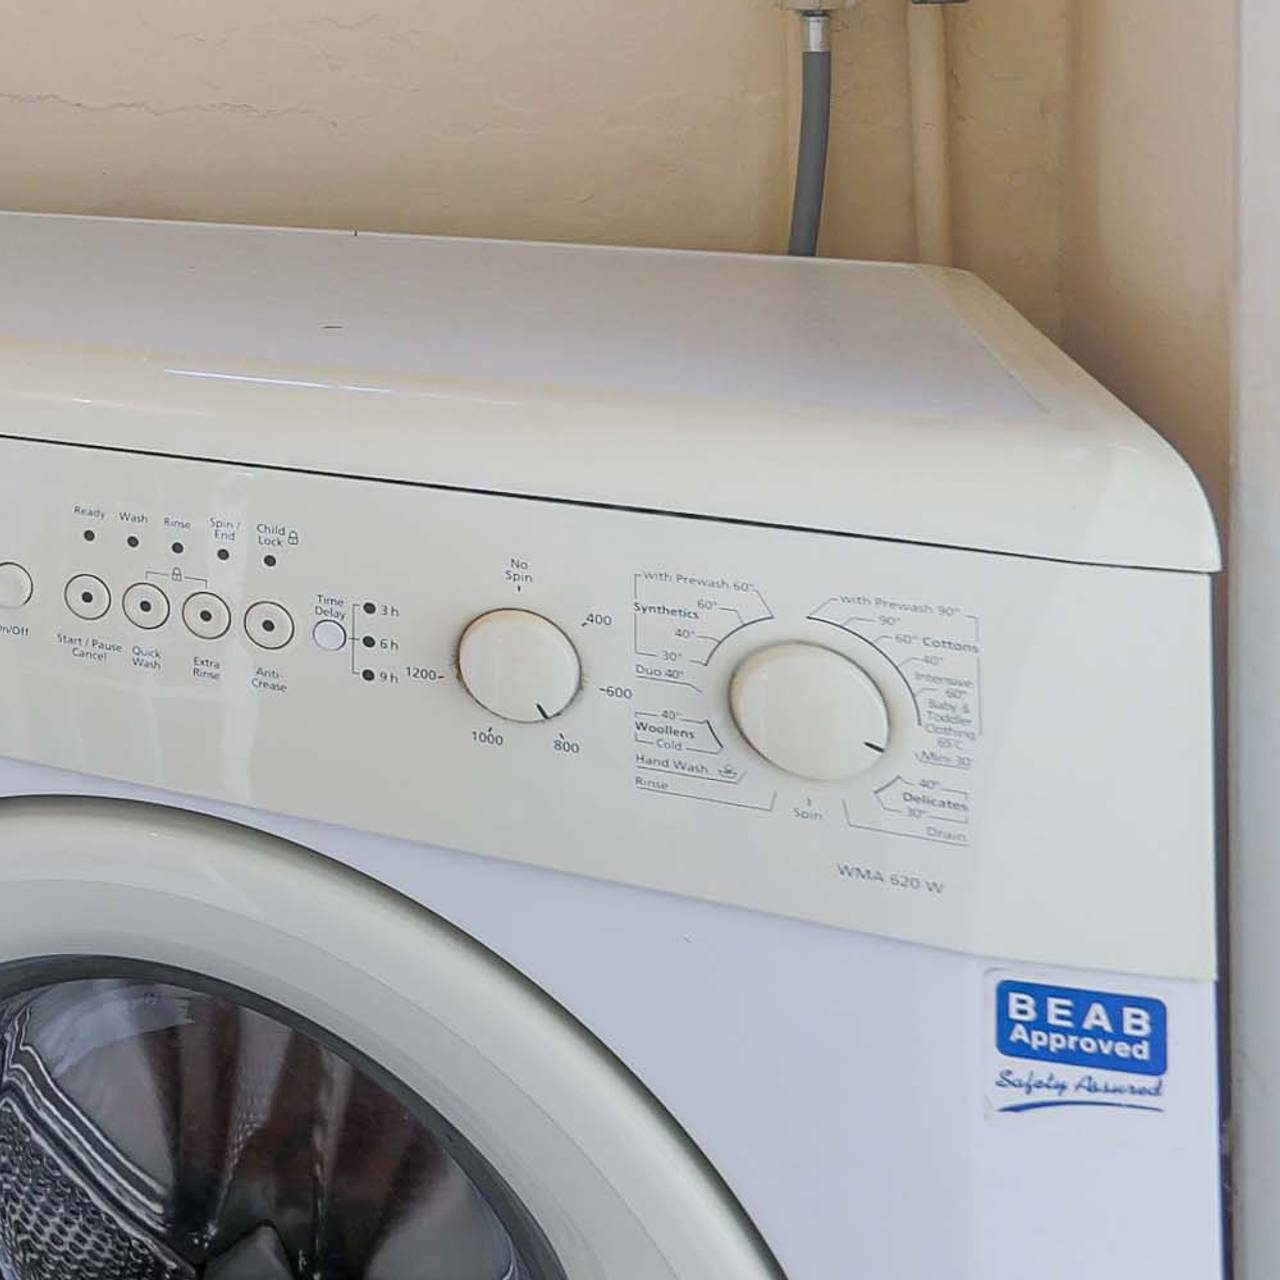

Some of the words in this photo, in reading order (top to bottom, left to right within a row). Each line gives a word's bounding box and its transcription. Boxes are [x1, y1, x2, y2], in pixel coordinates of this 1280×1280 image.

[73, 505, 106, 521] Ready
[119, 511, 149, 524] Wash
[163, 517, 192, 529] Rinse
[209, 517, 234, 530] Spin
[256, 523, 286, 536] Child
[214, 528, 236, 541] End
[258, 535, 284, 547] Lock
[510, 558, 529, 571] No
[505, 570, 533, 585] Spin
[676, 574, 730, 590] Prewash
[317, 594, 345, 607] Time
[875, 597, 934, 614] Prewash
[314, 605, 346, 621] Delay
[633, 602, 699, 620] Synthetics
[587, 613, 612, 626] 400
[56, 633, 83, 647] Start
[91, 638, 123, 653] Pause
[922, 637, 979, 654] Cottons
[72, 647, 107, 662] Cancel
[132, 645, 161, 659] Quick
[132, 658, 161, 670] Wash
[193, 656, 220, 670] Extra
[193, 668, 221, 681] Rinse
[405, 666, 437, 681] 1200
[251, 678, 288, 693] Crease
[606, 686, 633, 700] 600
[635, 720, 695, 739] Woollens
[472, 731, 504, 747] 1000
[553, 739, 580, 754] 800
[656, 738, 683, 751] Cold
[636, 754, 670, 768] Hand
[673, 760, 709, 774] Wash
[636, 776, 669, 790] Rinse
[903, 792, 969, 812] Delicates
[794, 807, 823, 821] Spin
[926, 826, 967, 842] Drain
[837, 863, 884, 882] WMA
[890, 873, 920, 889] 620
[925, 880, 944, 894] W
[1008, 991, 1152, 1037] BEAB
[1009, 1024, 1151, 1061] Approved
[995, 1070, 1068, 1096] Safety
[1074, 1075, 1163, 1097] Assured
